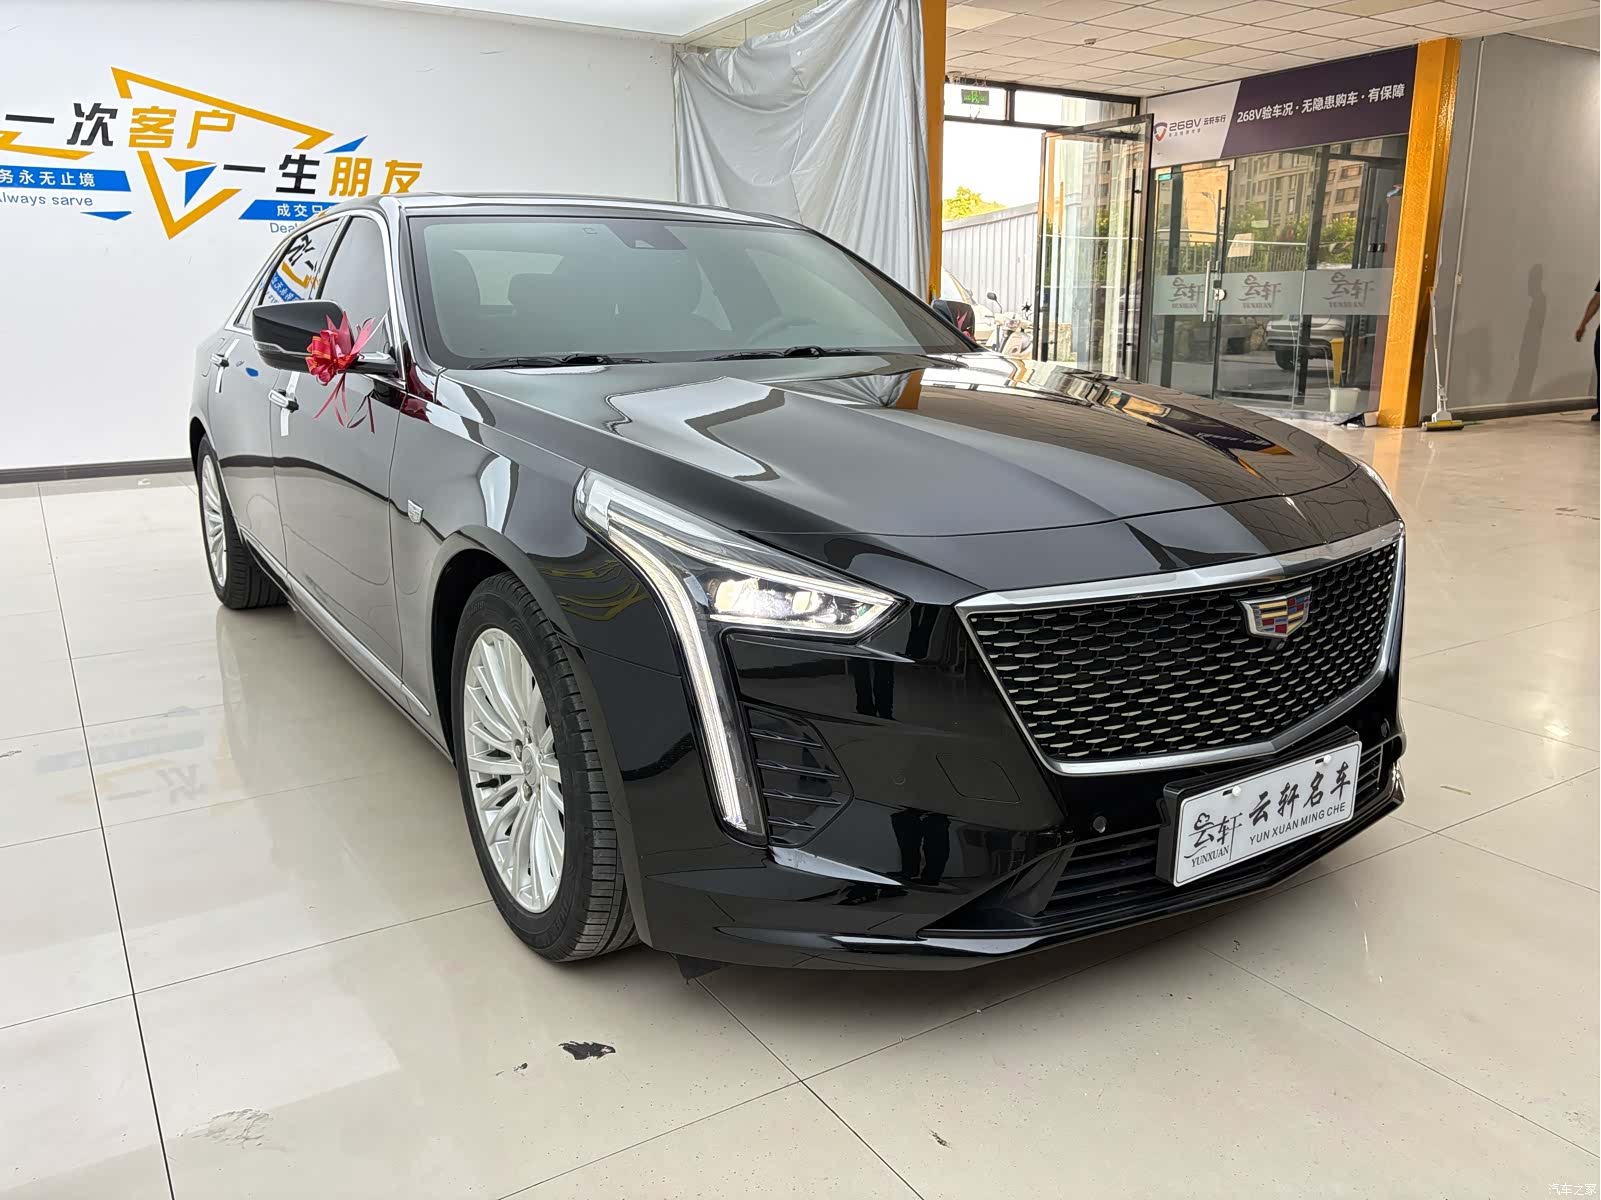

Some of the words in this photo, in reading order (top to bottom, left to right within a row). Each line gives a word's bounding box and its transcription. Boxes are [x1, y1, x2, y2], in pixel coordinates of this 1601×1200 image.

[5, 102, 236, 149] 一次客户
[1169, 118, 1201, 131] 268V
[223, 154, 423, 195] 一生朋友
[0, 191, 46, 206] lways
[52, 195, 93, 206] sarve
[1249, 761, 1351, 826] 云轩名车
[1184, 812, 1243, 860] 云轩
[1250, 832, 1270, 845] YUN
[1272, 821, 1299, 838] XUAN
[1300, 810, 1325, 826] MING
[1327, 802, 1346, 817] CHE
[1191, 845, 1229, 868] YUNXUAN
